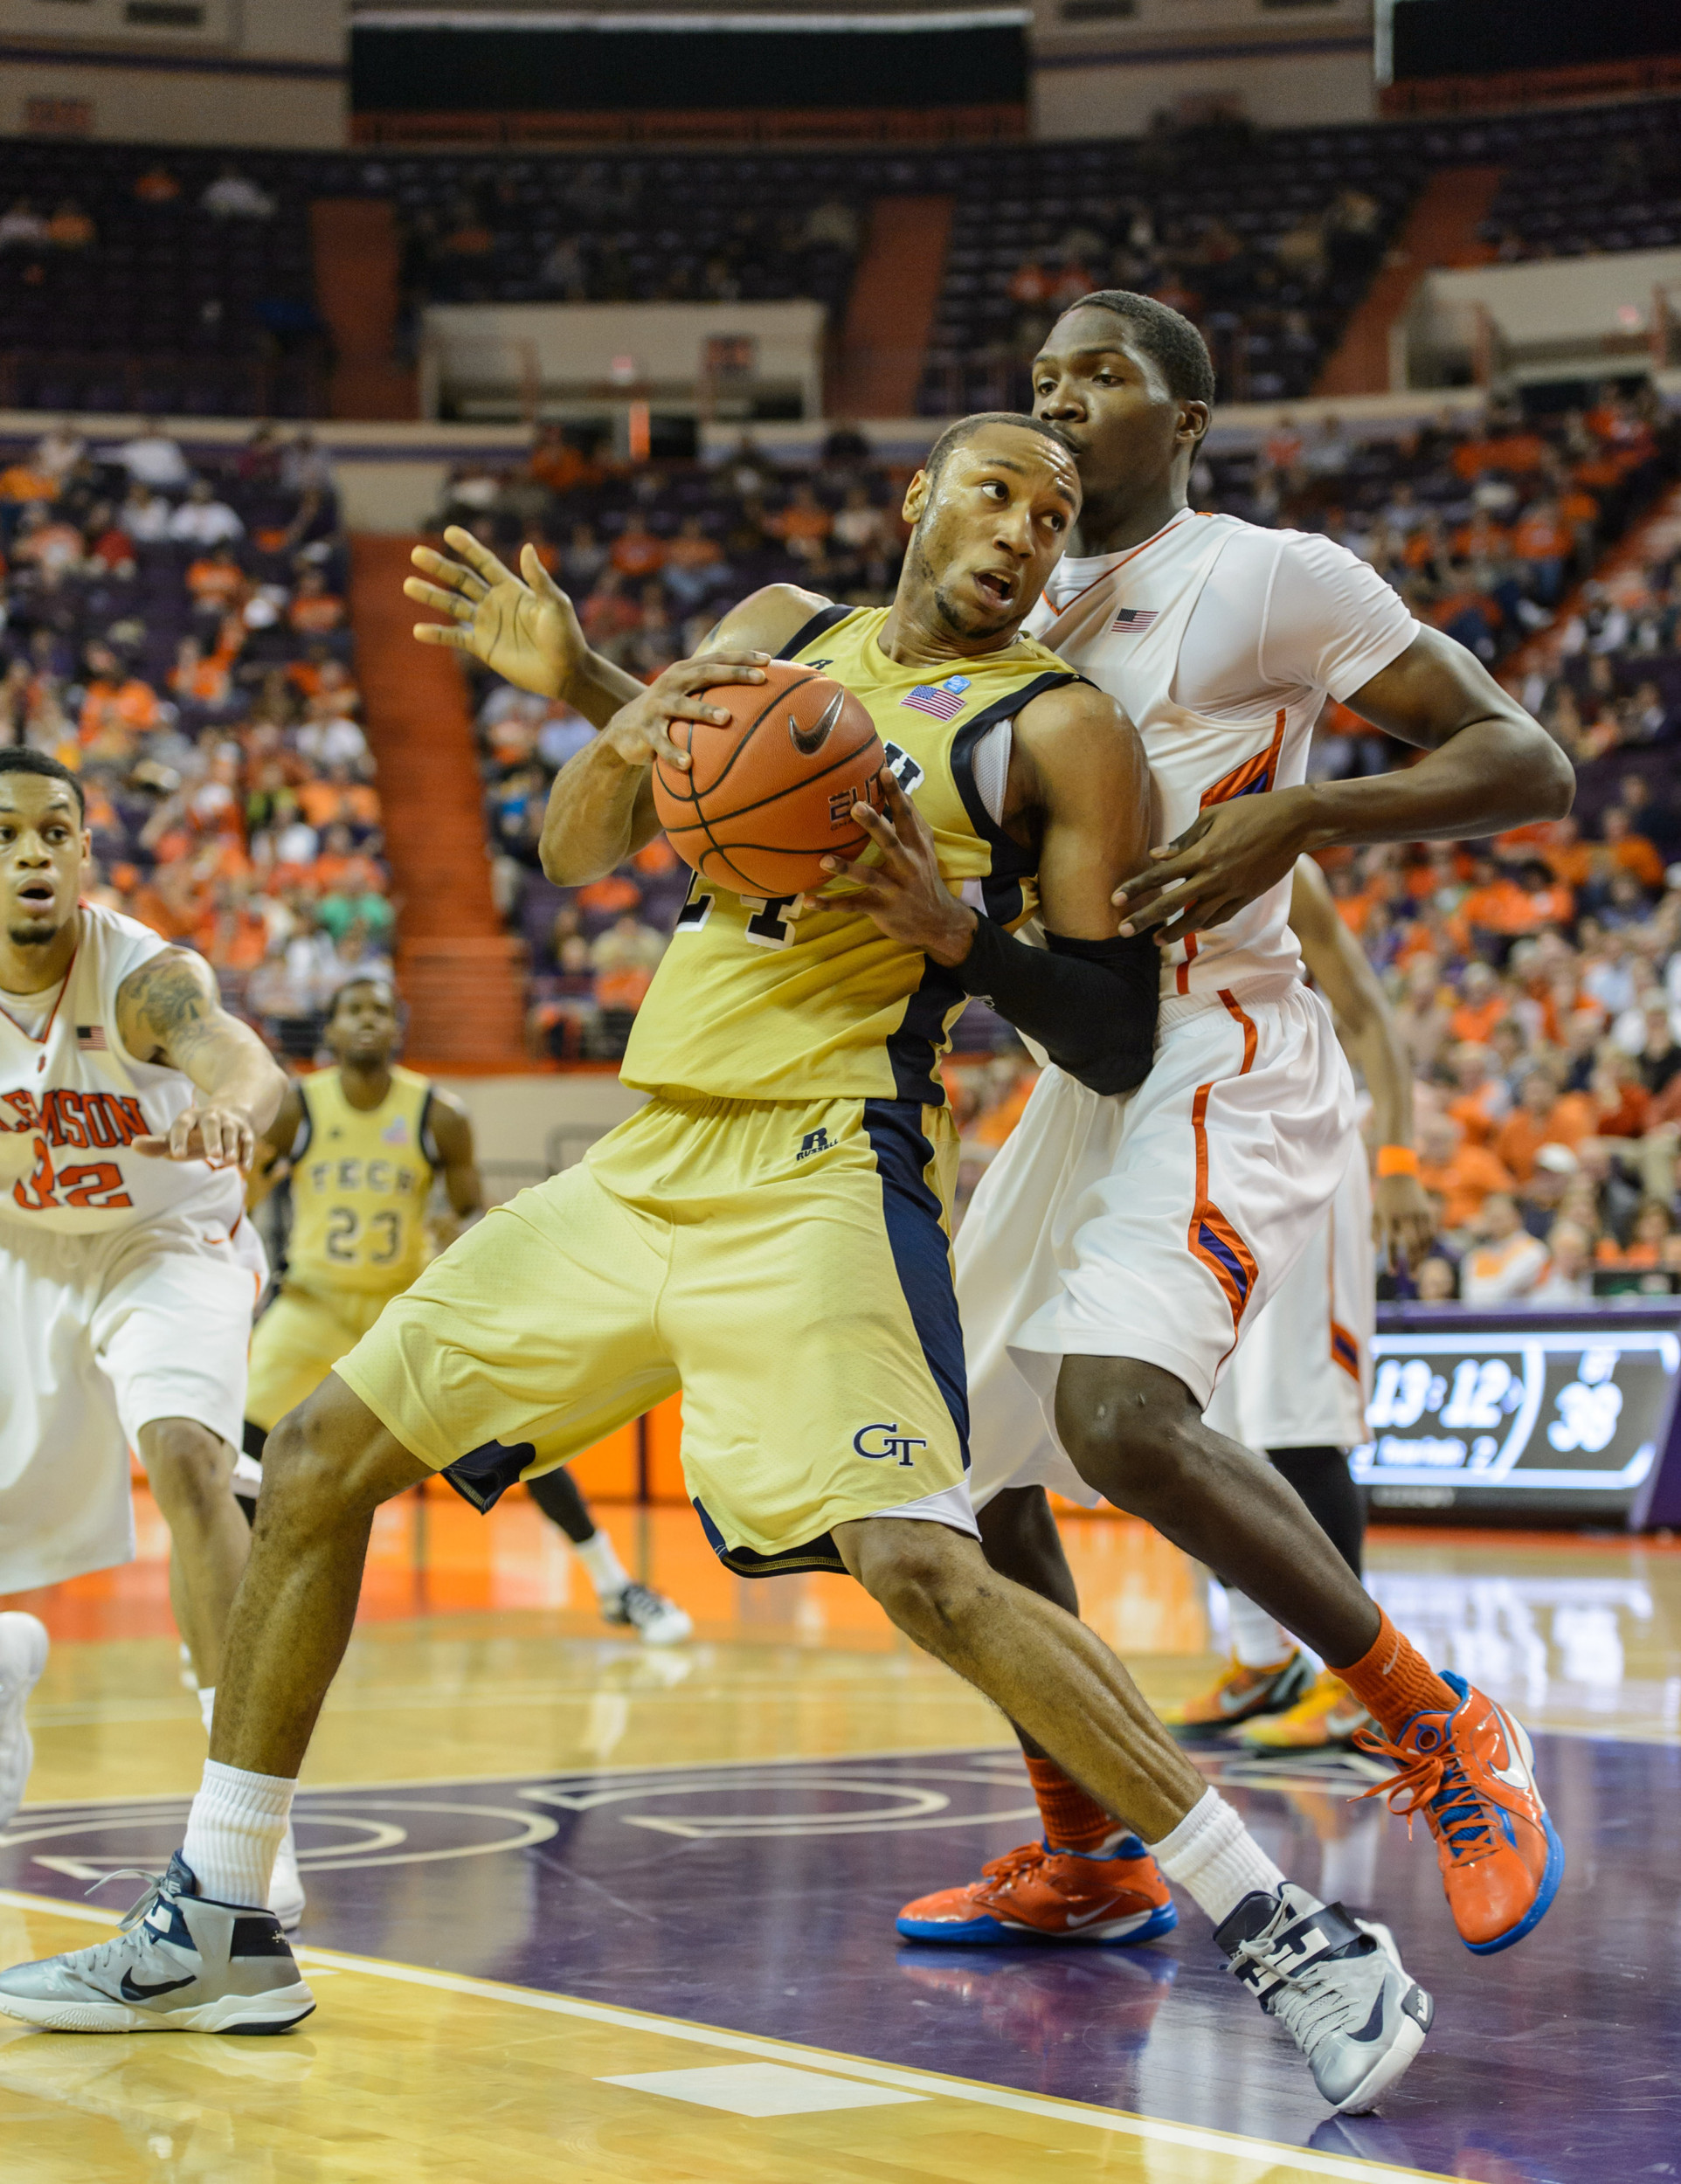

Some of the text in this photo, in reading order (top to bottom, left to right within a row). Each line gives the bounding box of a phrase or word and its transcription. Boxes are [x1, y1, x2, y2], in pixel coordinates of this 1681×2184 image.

[796, 1138, 839, 1161] RUSSELL
[310, 1157, 415, 1196] TECH
[326, 1204, 405, 1267] 23
[853, 1422, 928, 1468] GT
